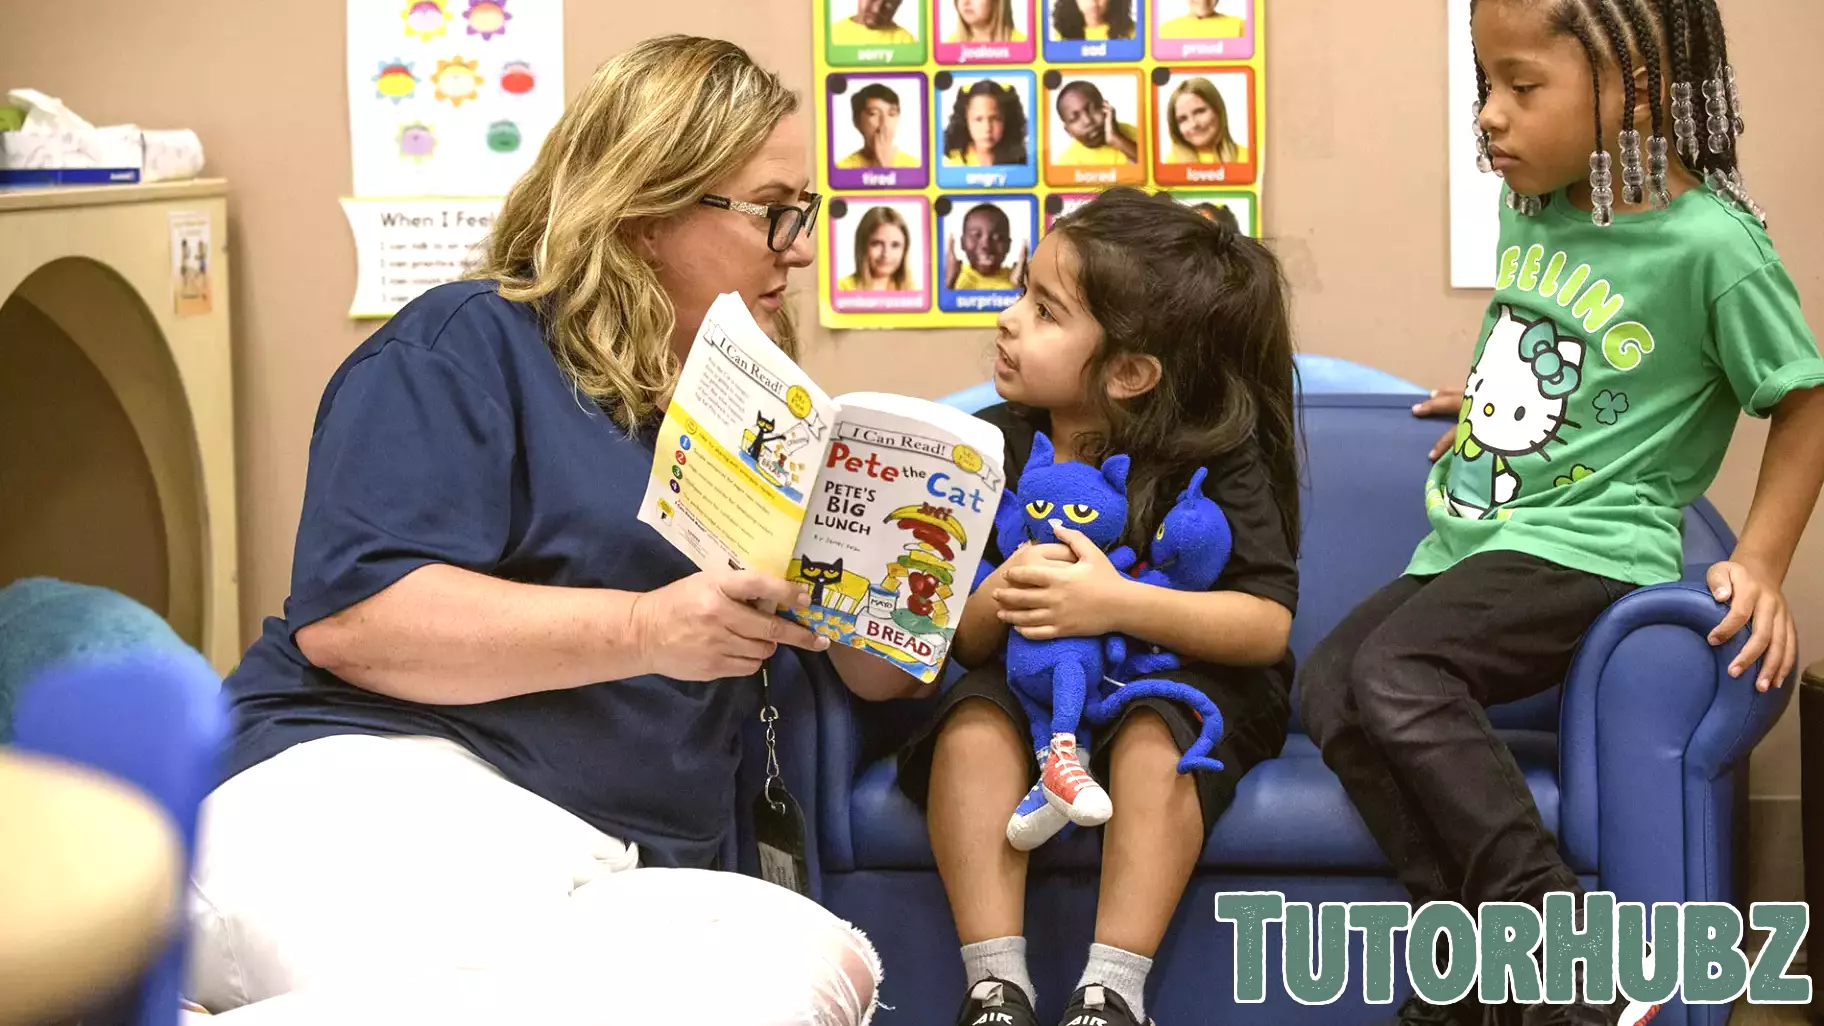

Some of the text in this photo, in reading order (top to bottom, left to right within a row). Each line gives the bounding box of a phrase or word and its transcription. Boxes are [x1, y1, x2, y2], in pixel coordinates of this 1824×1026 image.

[857, 48, 894, 63] sorry
[959, 45, 1010, 63] jealous
[1081, 43, 1107, 57] sad
[1182, 41, 1223, 58] proud
[862, 172, 896, 186] tired
[966, 173, 1007, 187] angry
[1074, 169, 1116, 183] bored
[1187, 168, 1225, 182] loved
[381, 212, 433, 228] When
[442, 211, 448, 228] I
[719, 337, 783, 395] I Can Read!
[852, 427, 946, 456] I Can Read!
[826, 441, 985, 513] Pete the Cat
[824, 480, 877, 503] PETE'S
[827, 495, 866, 517] BIG
[814, 513, 871, 536] LUNCH
[866, 620, 932, 657] BREAD
[972, 1012, 1013, 1026] AIR
